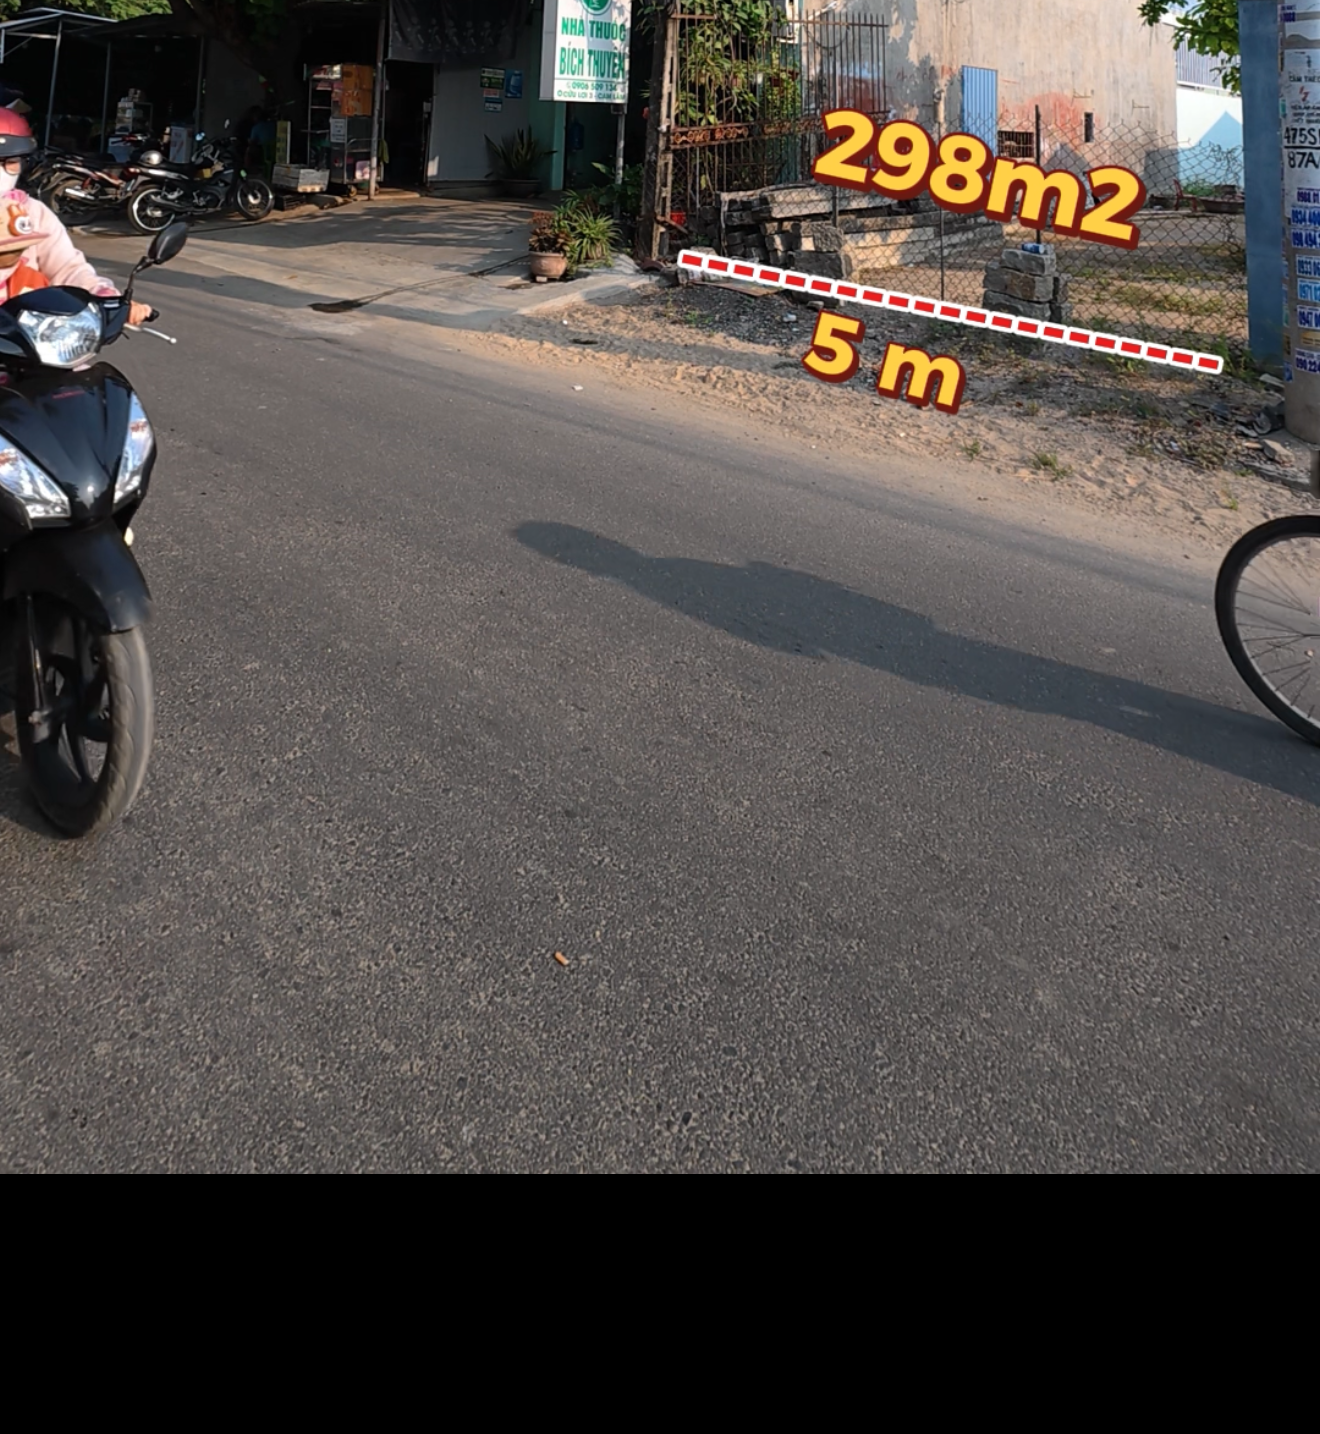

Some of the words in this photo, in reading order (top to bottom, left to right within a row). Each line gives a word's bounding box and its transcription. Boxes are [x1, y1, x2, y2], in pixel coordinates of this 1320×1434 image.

[561, 15, 585, 37] NHÀ
[589, 17, 627, 42] THUỐC
[559, 41, 585, 76] BÍCH
[1284, 126, 1320, 145] 475S
[1287, 151, 1320, 169] 87A
